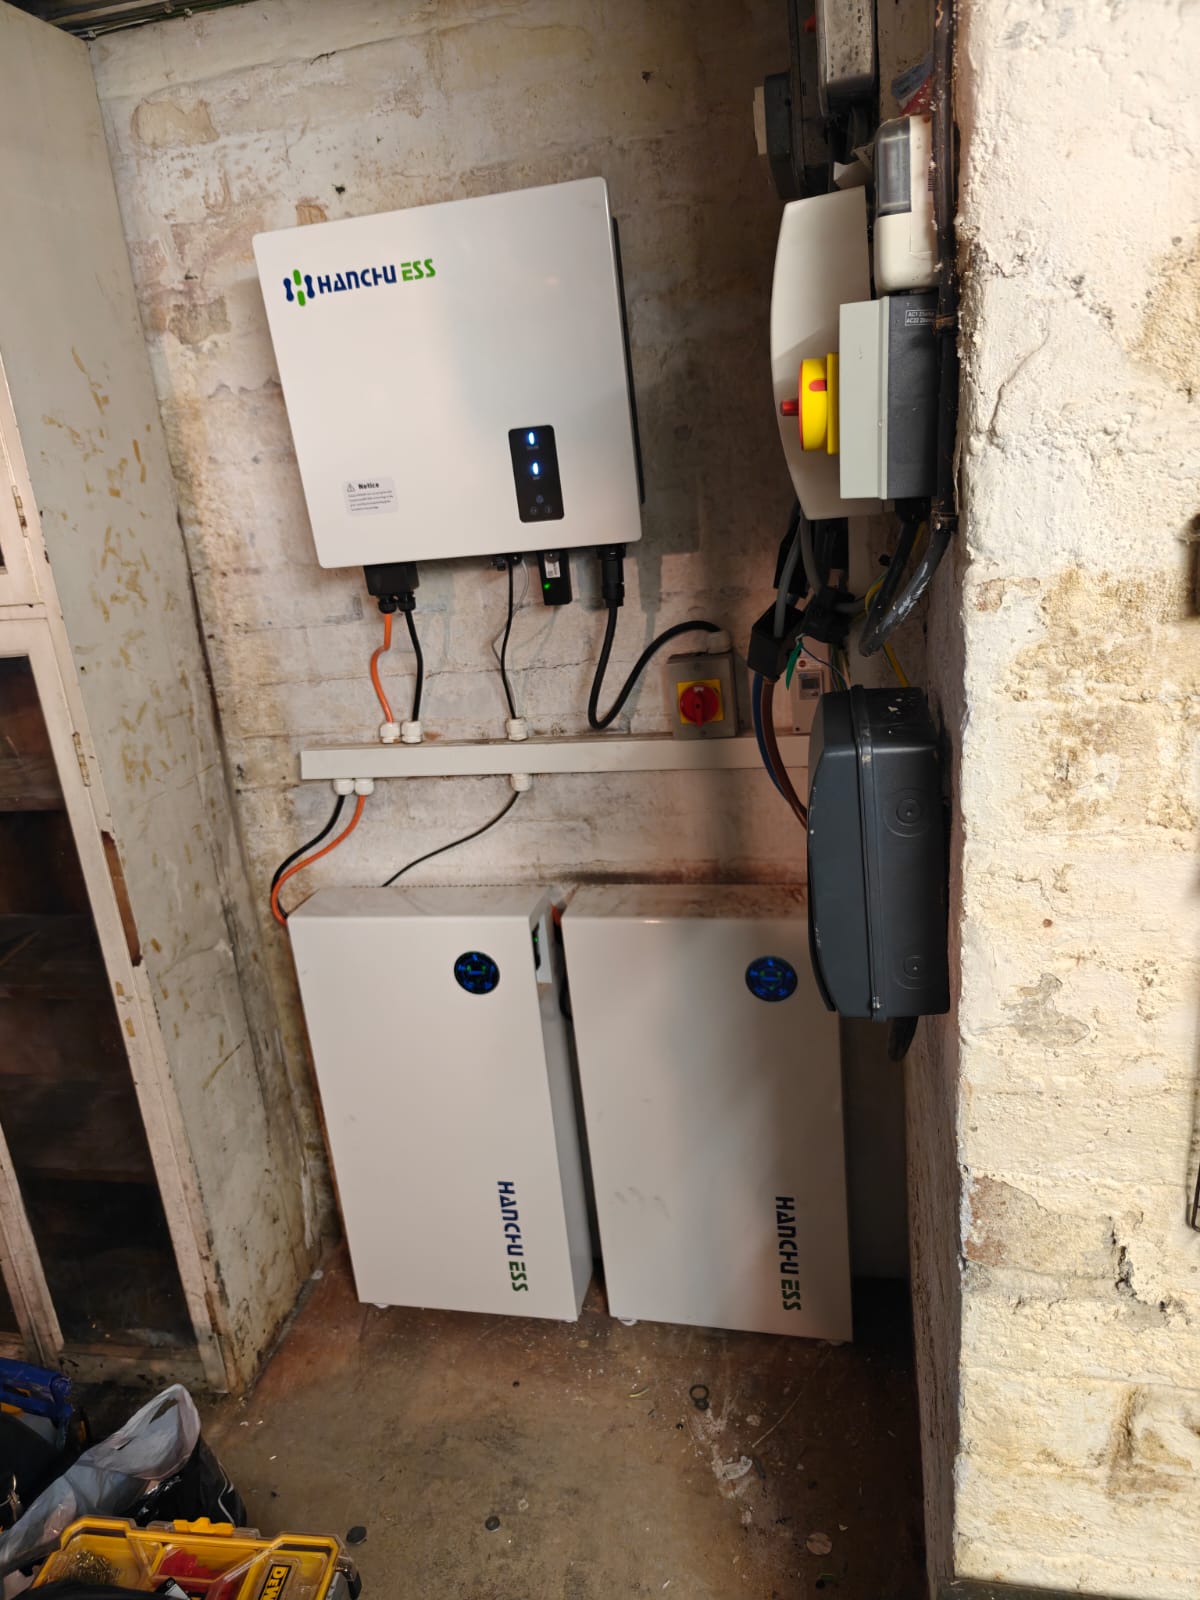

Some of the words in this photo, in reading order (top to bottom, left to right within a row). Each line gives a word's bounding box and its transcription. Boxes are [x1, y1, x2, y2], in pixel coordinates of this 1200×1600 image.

[317, 264, 397, 294] HANCHU
[400, 258, 436, 281] ESS
[497, 1181, 524, 1256] HANCHU
[775, 1196, 799, 1275] HANCHU
[509, 1261, 528, 1292] ESS
[781, 1279, 802, 1311] ESS
